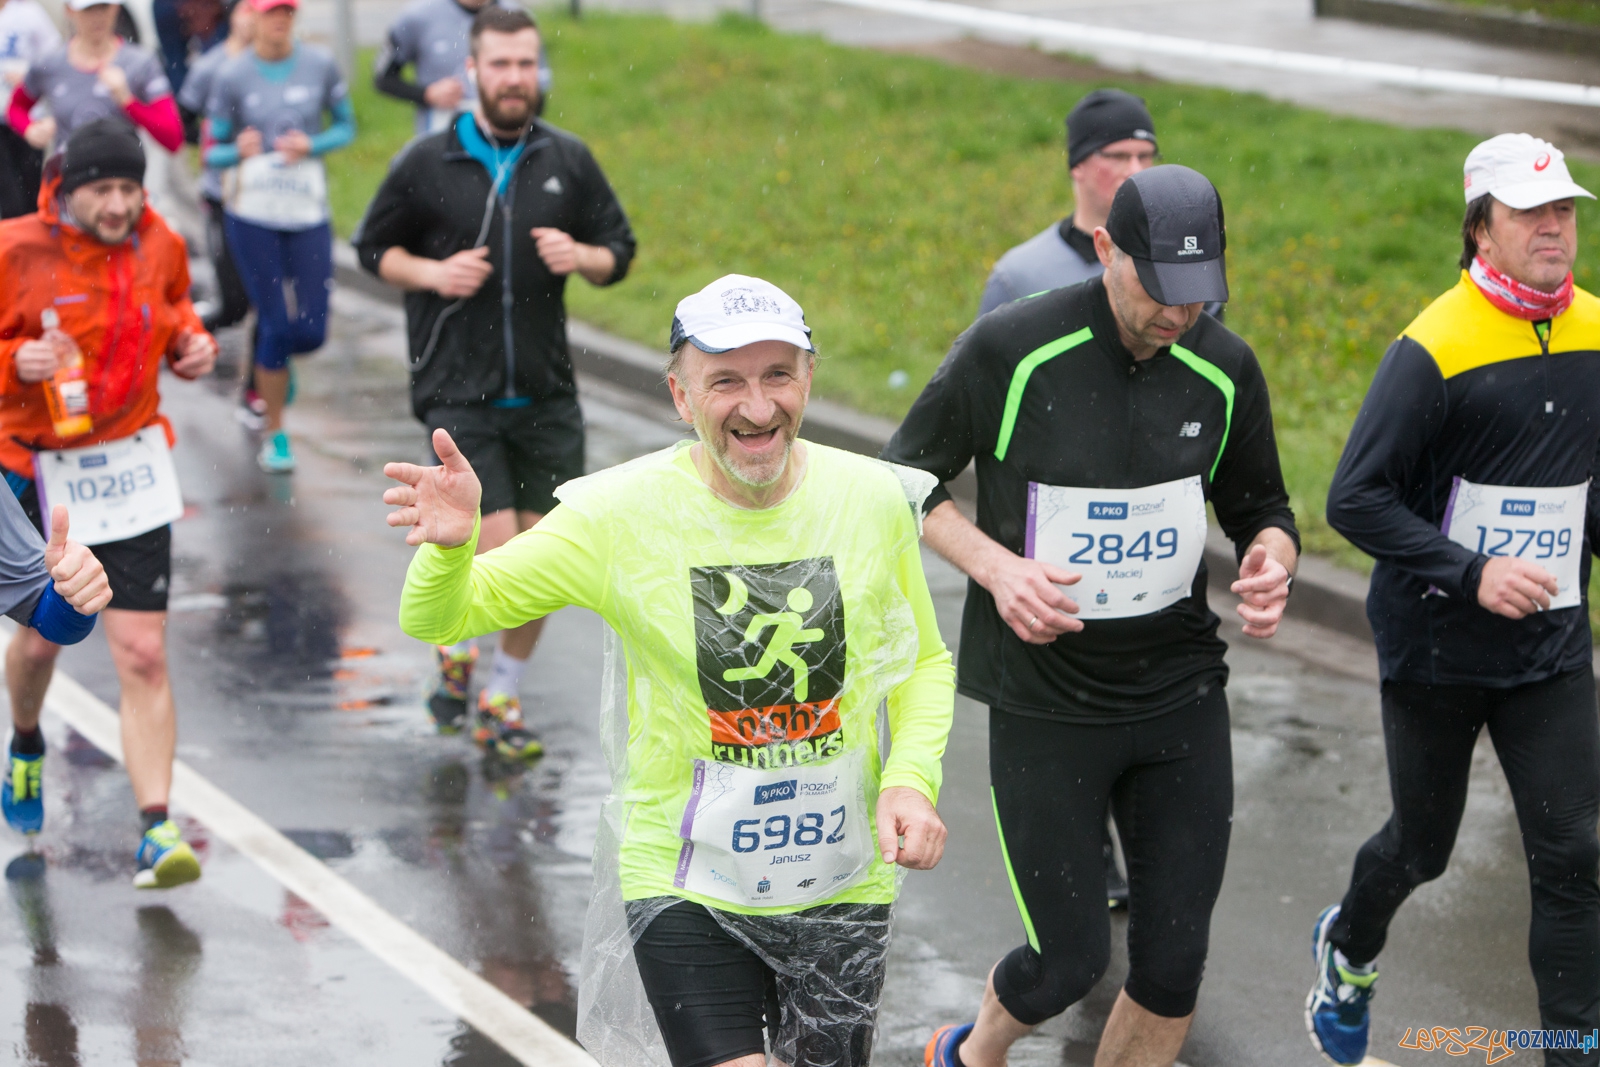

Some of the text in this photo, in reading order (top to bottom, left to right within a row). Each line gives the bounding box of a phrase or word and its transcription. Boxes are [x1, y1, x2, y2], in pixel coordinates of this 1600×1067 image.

[65, 463, 156, 504] 10283
[1068, 527, 1178, 565] 2849
[1476, 524, 1572, 559] 12799
[1106, 568, 1143, 580] Maciej
[736, 703, 822, 740] night
[713, 731, 844, 769] runners
[731, 804, 847, 854] 6982
[769, 853, 812, 866] Janusz
